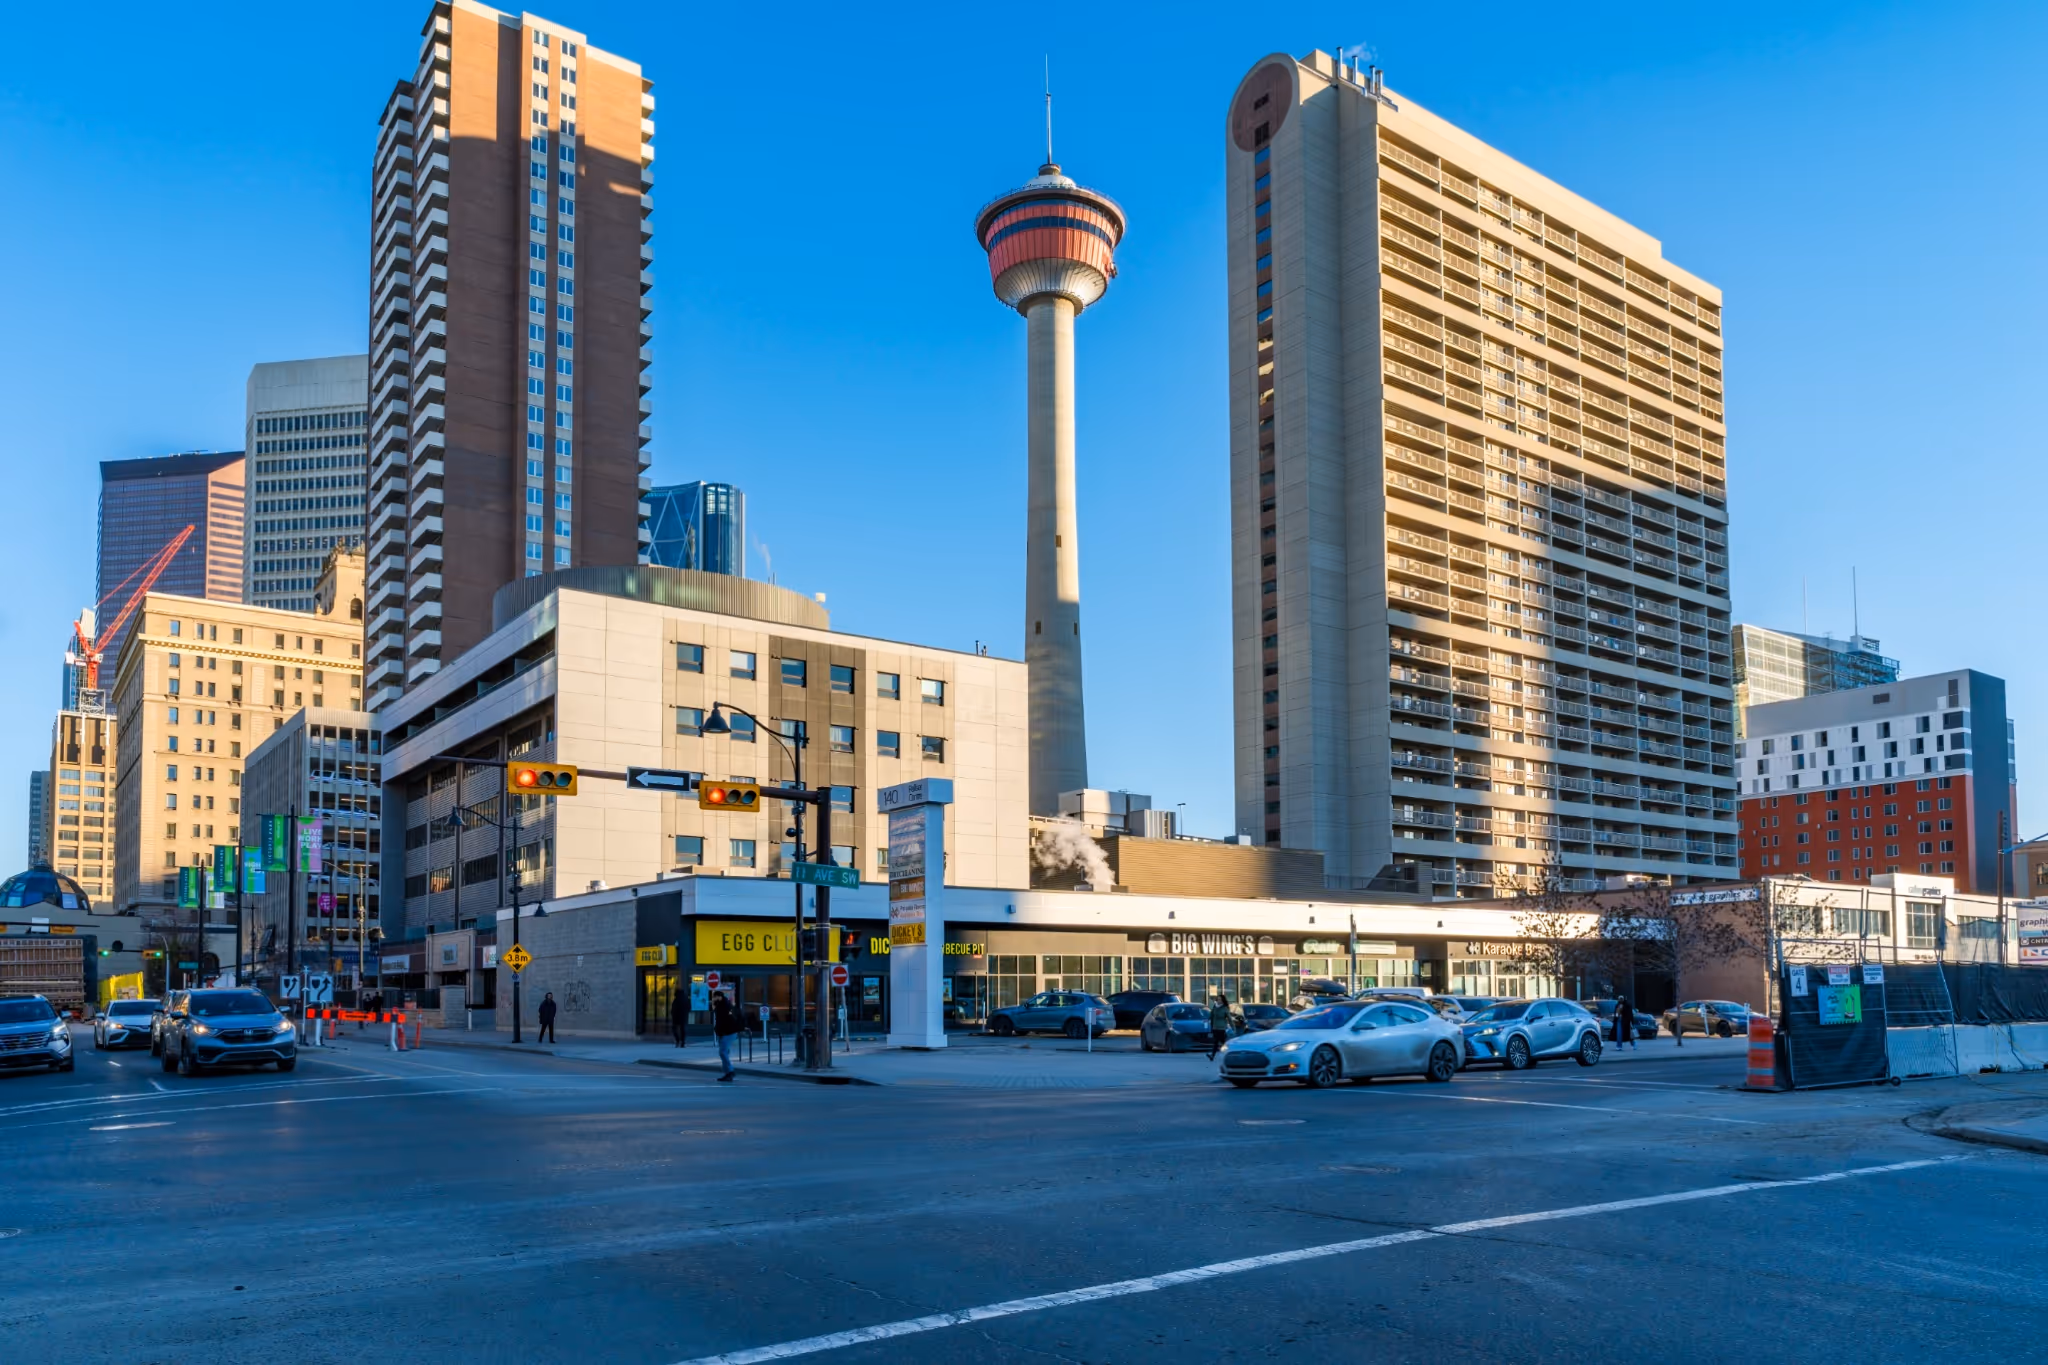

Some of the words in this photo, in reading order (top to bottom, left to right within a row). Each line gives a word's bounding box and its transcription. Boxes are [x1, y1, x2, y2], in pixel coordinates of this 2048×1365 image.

[884, 789, 899, 806] 140
[814, 868, 835, 882] AVE
[842, 872, 857, 885] SW
[722, 933, 755, 951] EGG
[763, 934, 796, 952] CLU
[942, 943, 970, 955] BECUE
[972, 943, 985, 955] PIT
[1172, 932, 1197, 954] BIG
[1201, 933, 1255, 955] WING'S
[1482, 941, 1523, 957] Karaoke
[508, 954, 519, 962] 3.8
[1796, 977, 1802, 992] 4
